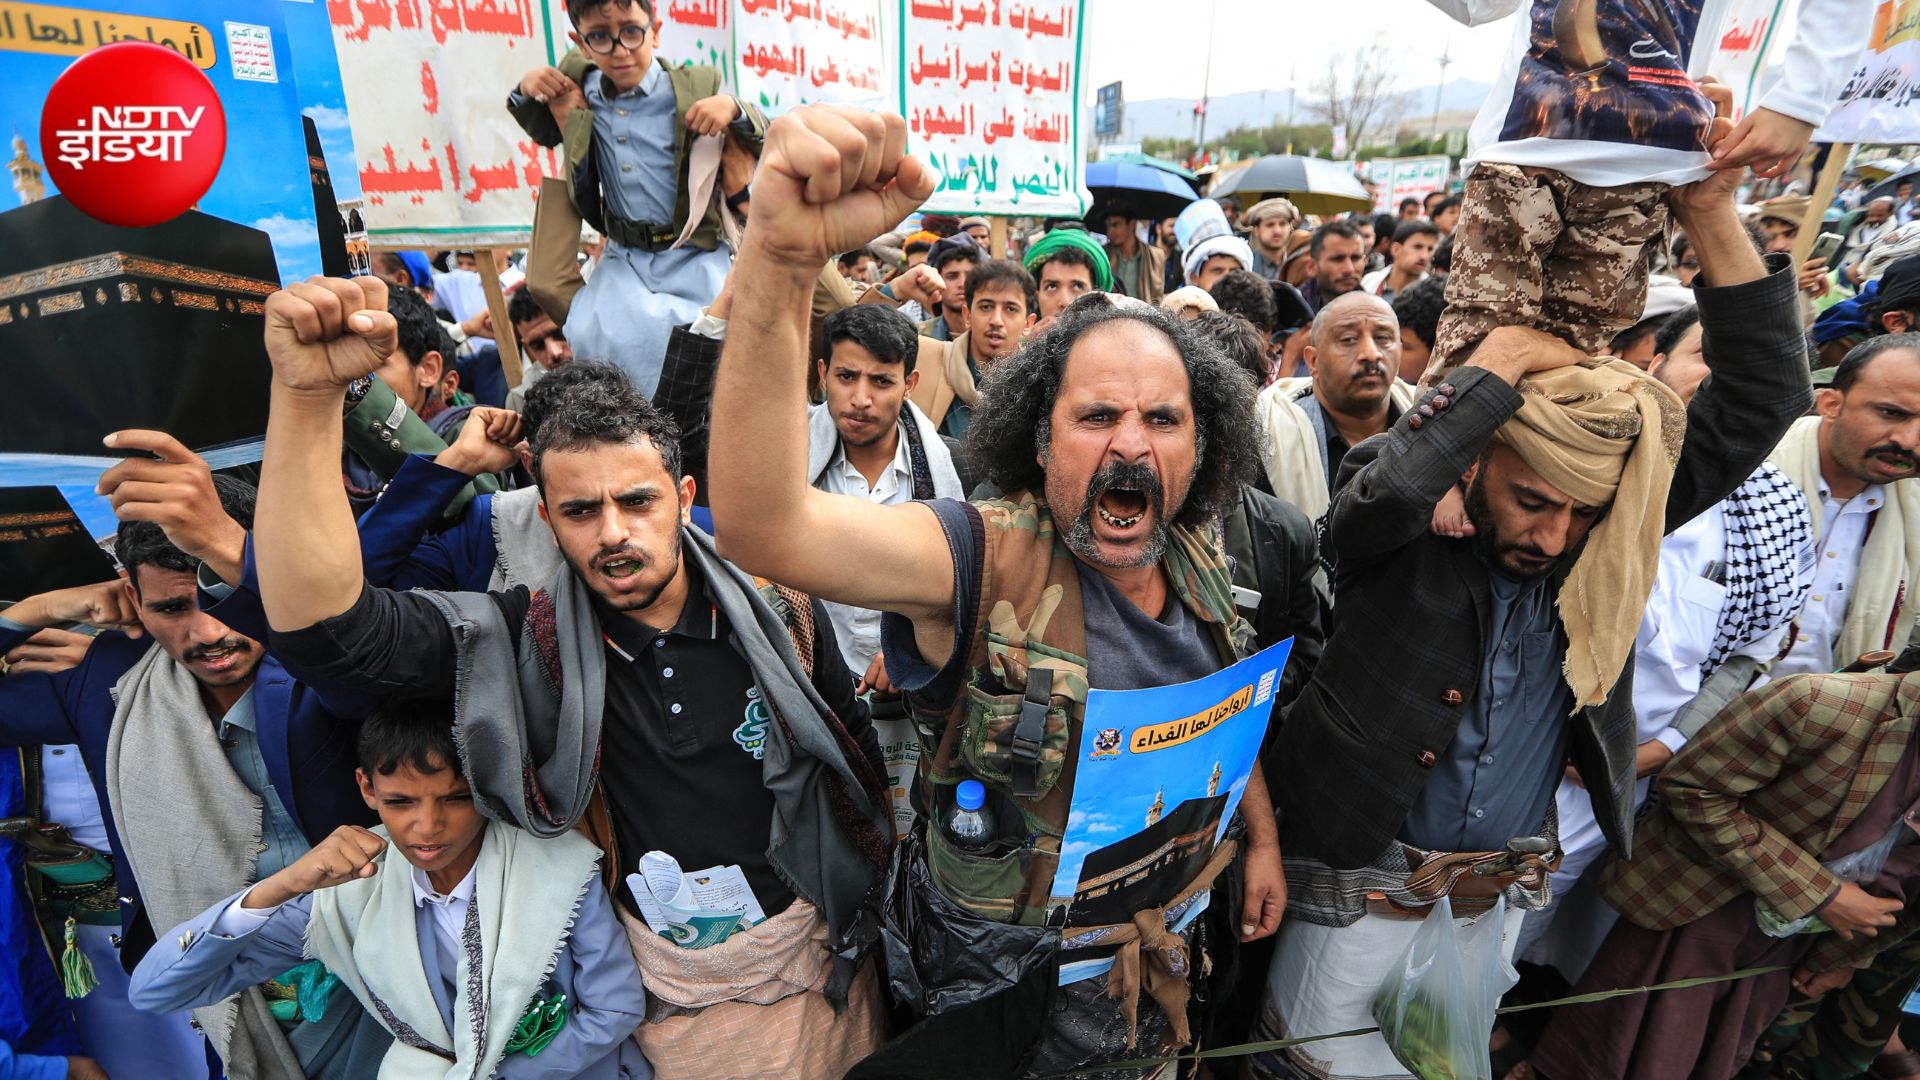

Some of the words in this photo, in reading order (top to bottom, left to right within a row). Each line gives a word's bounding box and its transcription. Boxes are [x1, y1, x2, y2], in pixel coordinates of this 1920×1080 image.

[24, 12, 85, 46] لها
[1009, 3, 1072, 39] الموت
[742, 42, 805, 81] اليهود
[1008, 59, 1069, 95] الموت
[911, 102, 975, 143] اليهود
[983, 105, 1014, 144] على
[1024, 108, 1069, 144] اللعنة
[930, 151, 999, 206] للإسلا
[1009, 154, 1069, 205] النصر
[1213, 685, 1251, 724] أرواحنا
[1136, 722, 1188, 748] الفداء
[1189, 711, 1213, 736] لها
